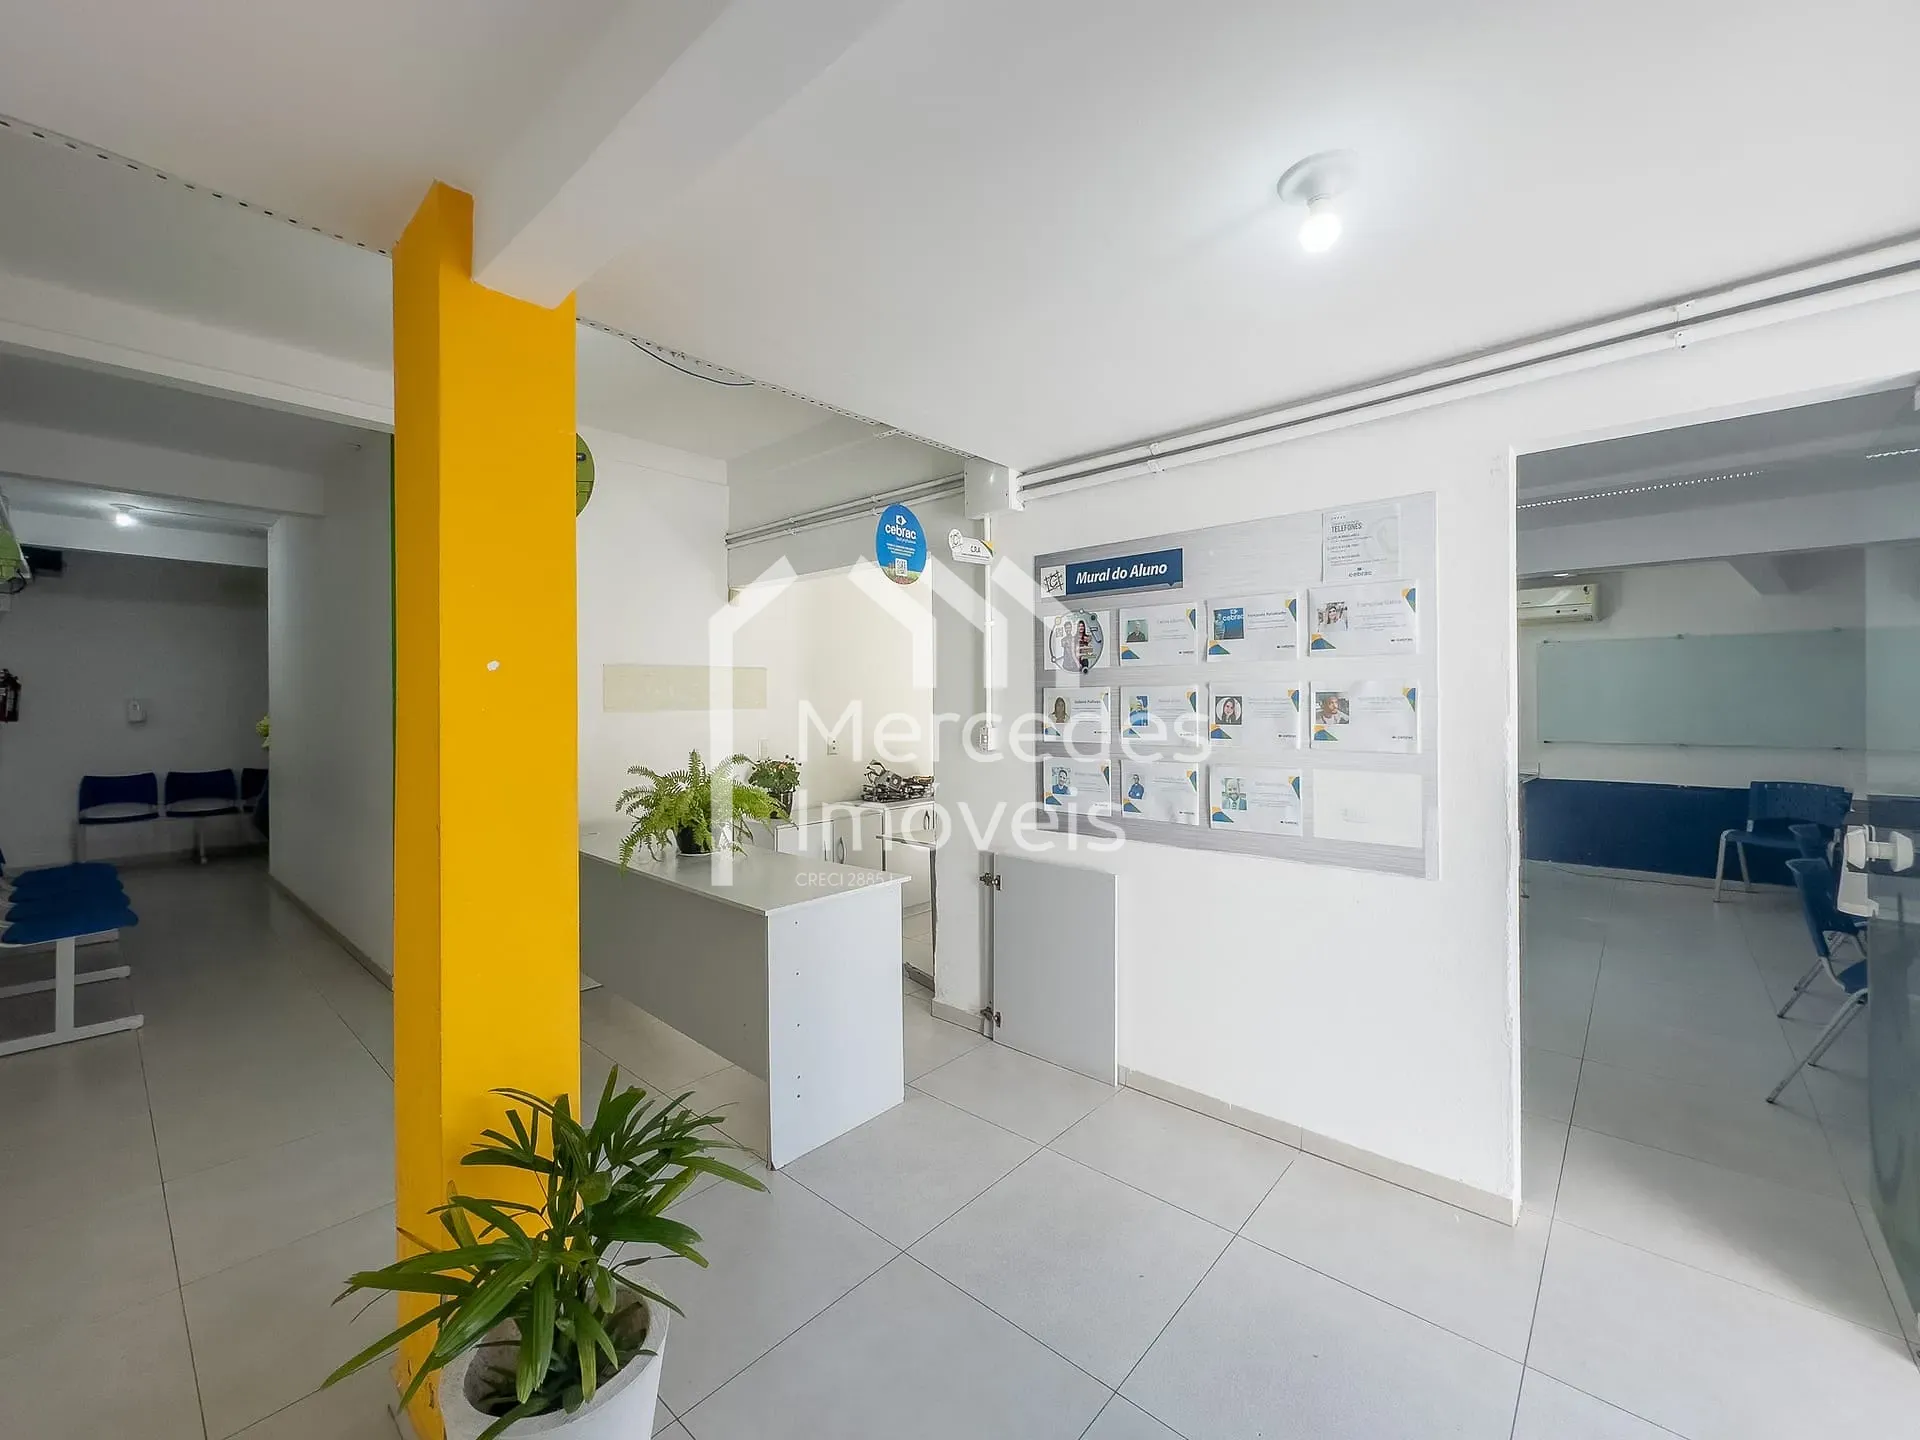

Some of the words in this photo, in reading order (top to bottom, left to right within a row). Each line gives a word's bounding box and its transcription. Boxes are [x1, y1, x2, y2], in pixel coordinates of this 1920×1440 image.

[885, 523, 917, 540] cebrac
[1075, 567, 1110, 585] Mural
[1111, 566, 1128, 580] do
[1129, 563, 1168, 578] Aluno
